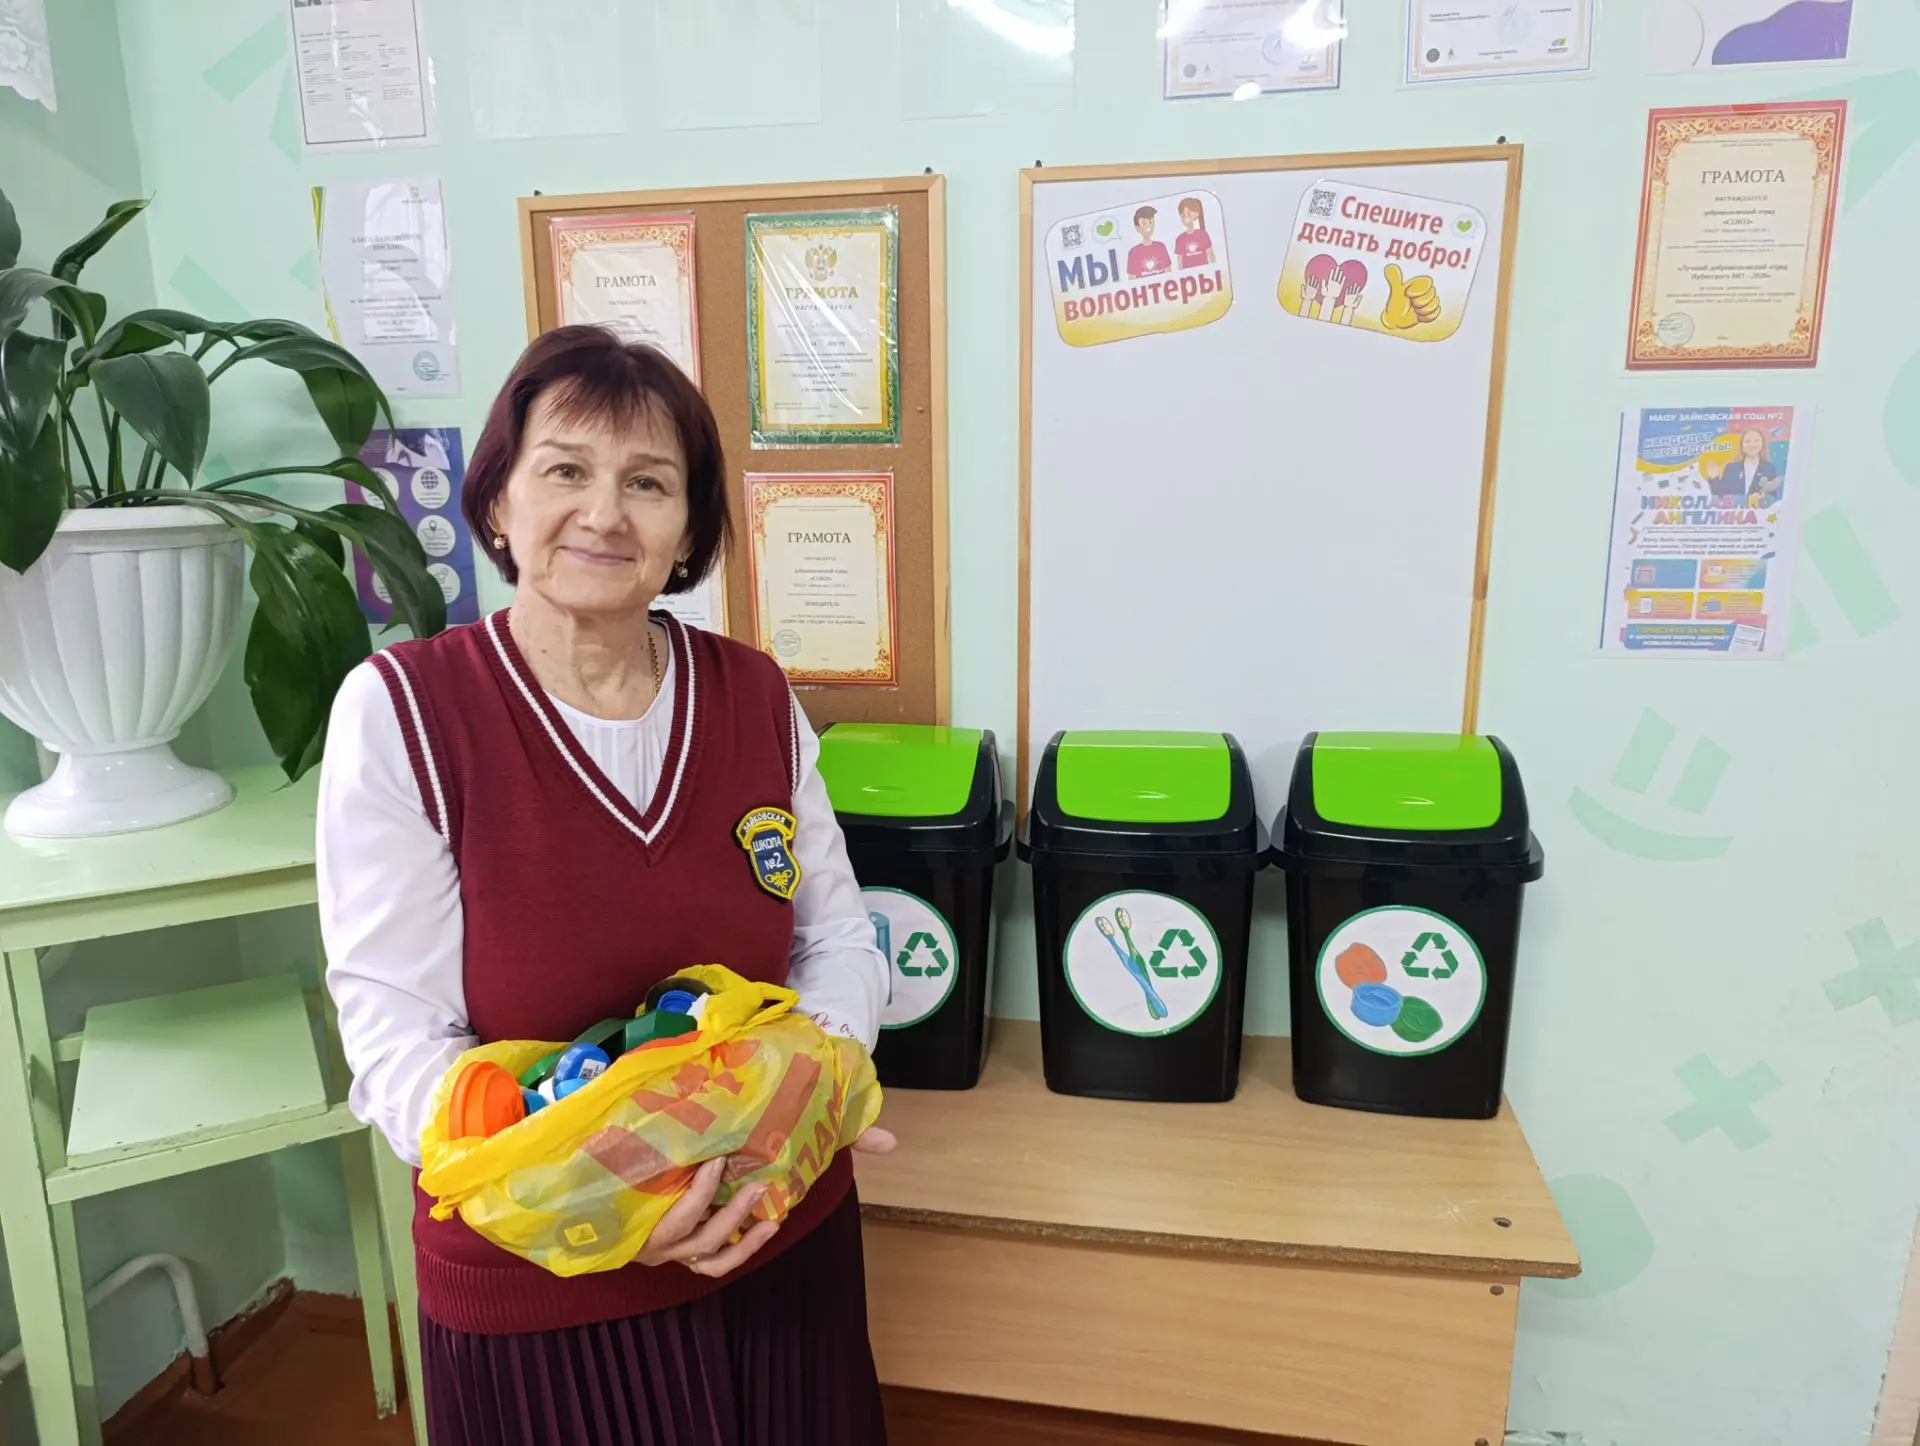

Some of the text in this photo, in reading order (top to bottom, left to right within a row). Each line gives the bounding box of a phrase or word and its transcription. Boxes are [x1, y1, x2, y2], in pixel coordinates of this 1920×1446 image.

[1700, 169, 1786, 184] ГРАМОТА
[1341, 195, 1444, 235] Спешите
[1297, 222, 1471, 269] делать добро!
[1057, 248, 1120, 293] МЫ
[595, 275, 657, 288] ГРАМОТА
[1063, 269, 1223, 322] волонтеры
[1649, 414, 1675, 422] МАОУ
[1678, 411, 1741, 422] ЗАЙКОВСКАЯ
[1743, 412, 1766, 420] СОШ
[1653, 510, 1758, 525] АНГЕЛИНА
[787, 532, 852, 544] ГРАМОТА
[752, 835, 783, 853] ШКОЛА
[764, 852, 785, 870] №2
